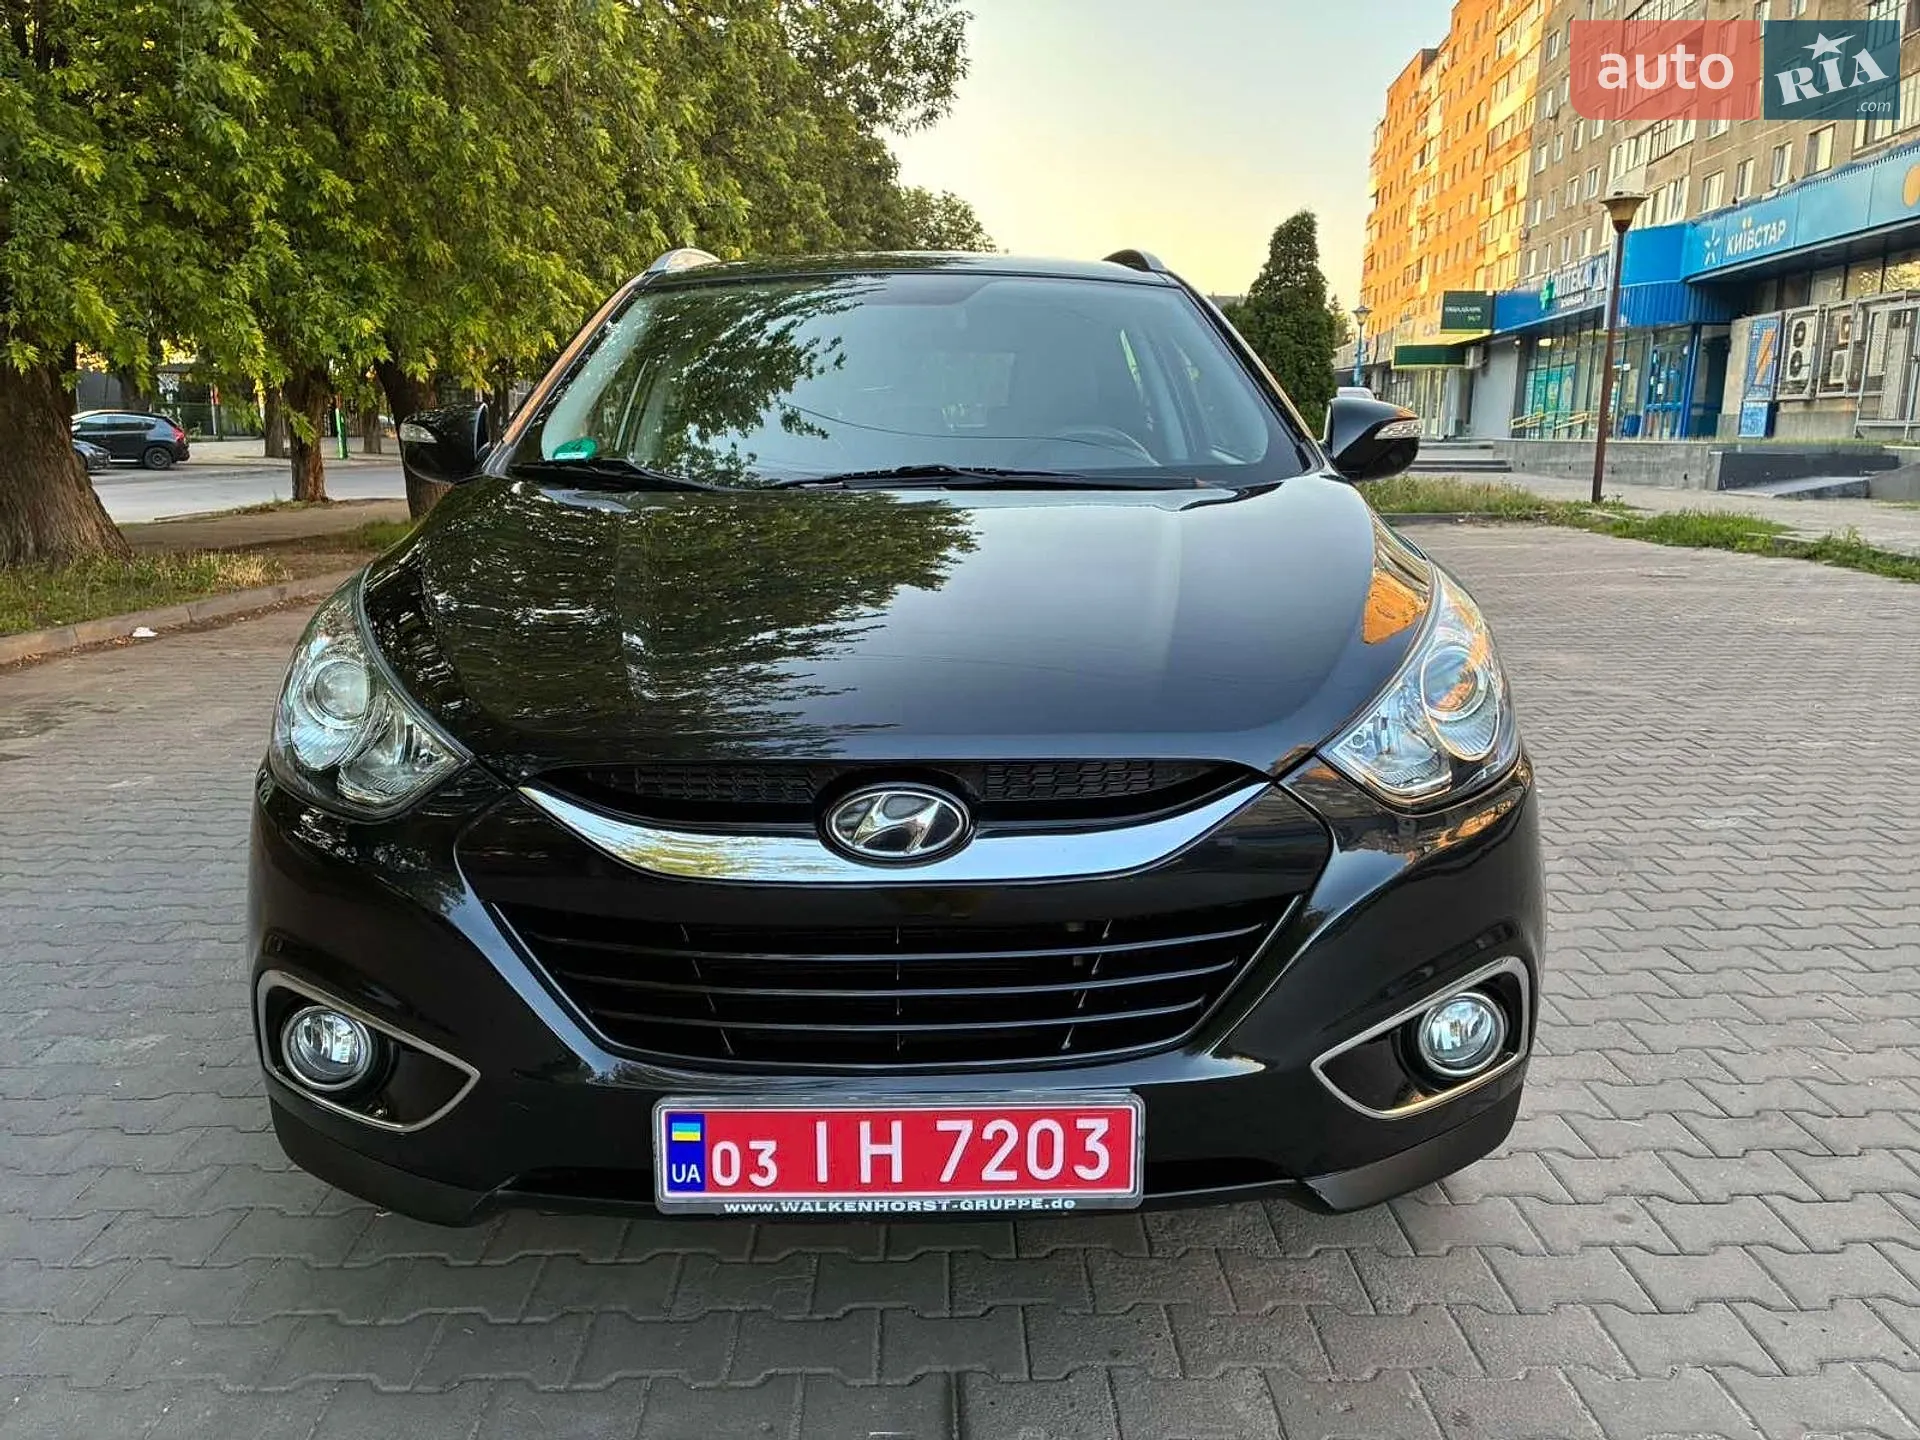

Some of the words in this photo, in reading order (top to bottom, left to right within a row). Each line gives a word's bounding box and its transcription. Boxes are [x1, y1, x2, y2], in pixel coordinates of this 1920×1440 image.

[1726, 216, 1786, 257] КИЇВСТАР
[711, 1139, 777, 1187] 03
[935, 1118, 1110, 1183] 7203
[671, 1163, 702, 1183] UA
[724, 1197, 1076, 1212] www.WALKENHORST-GRUPPE.de
